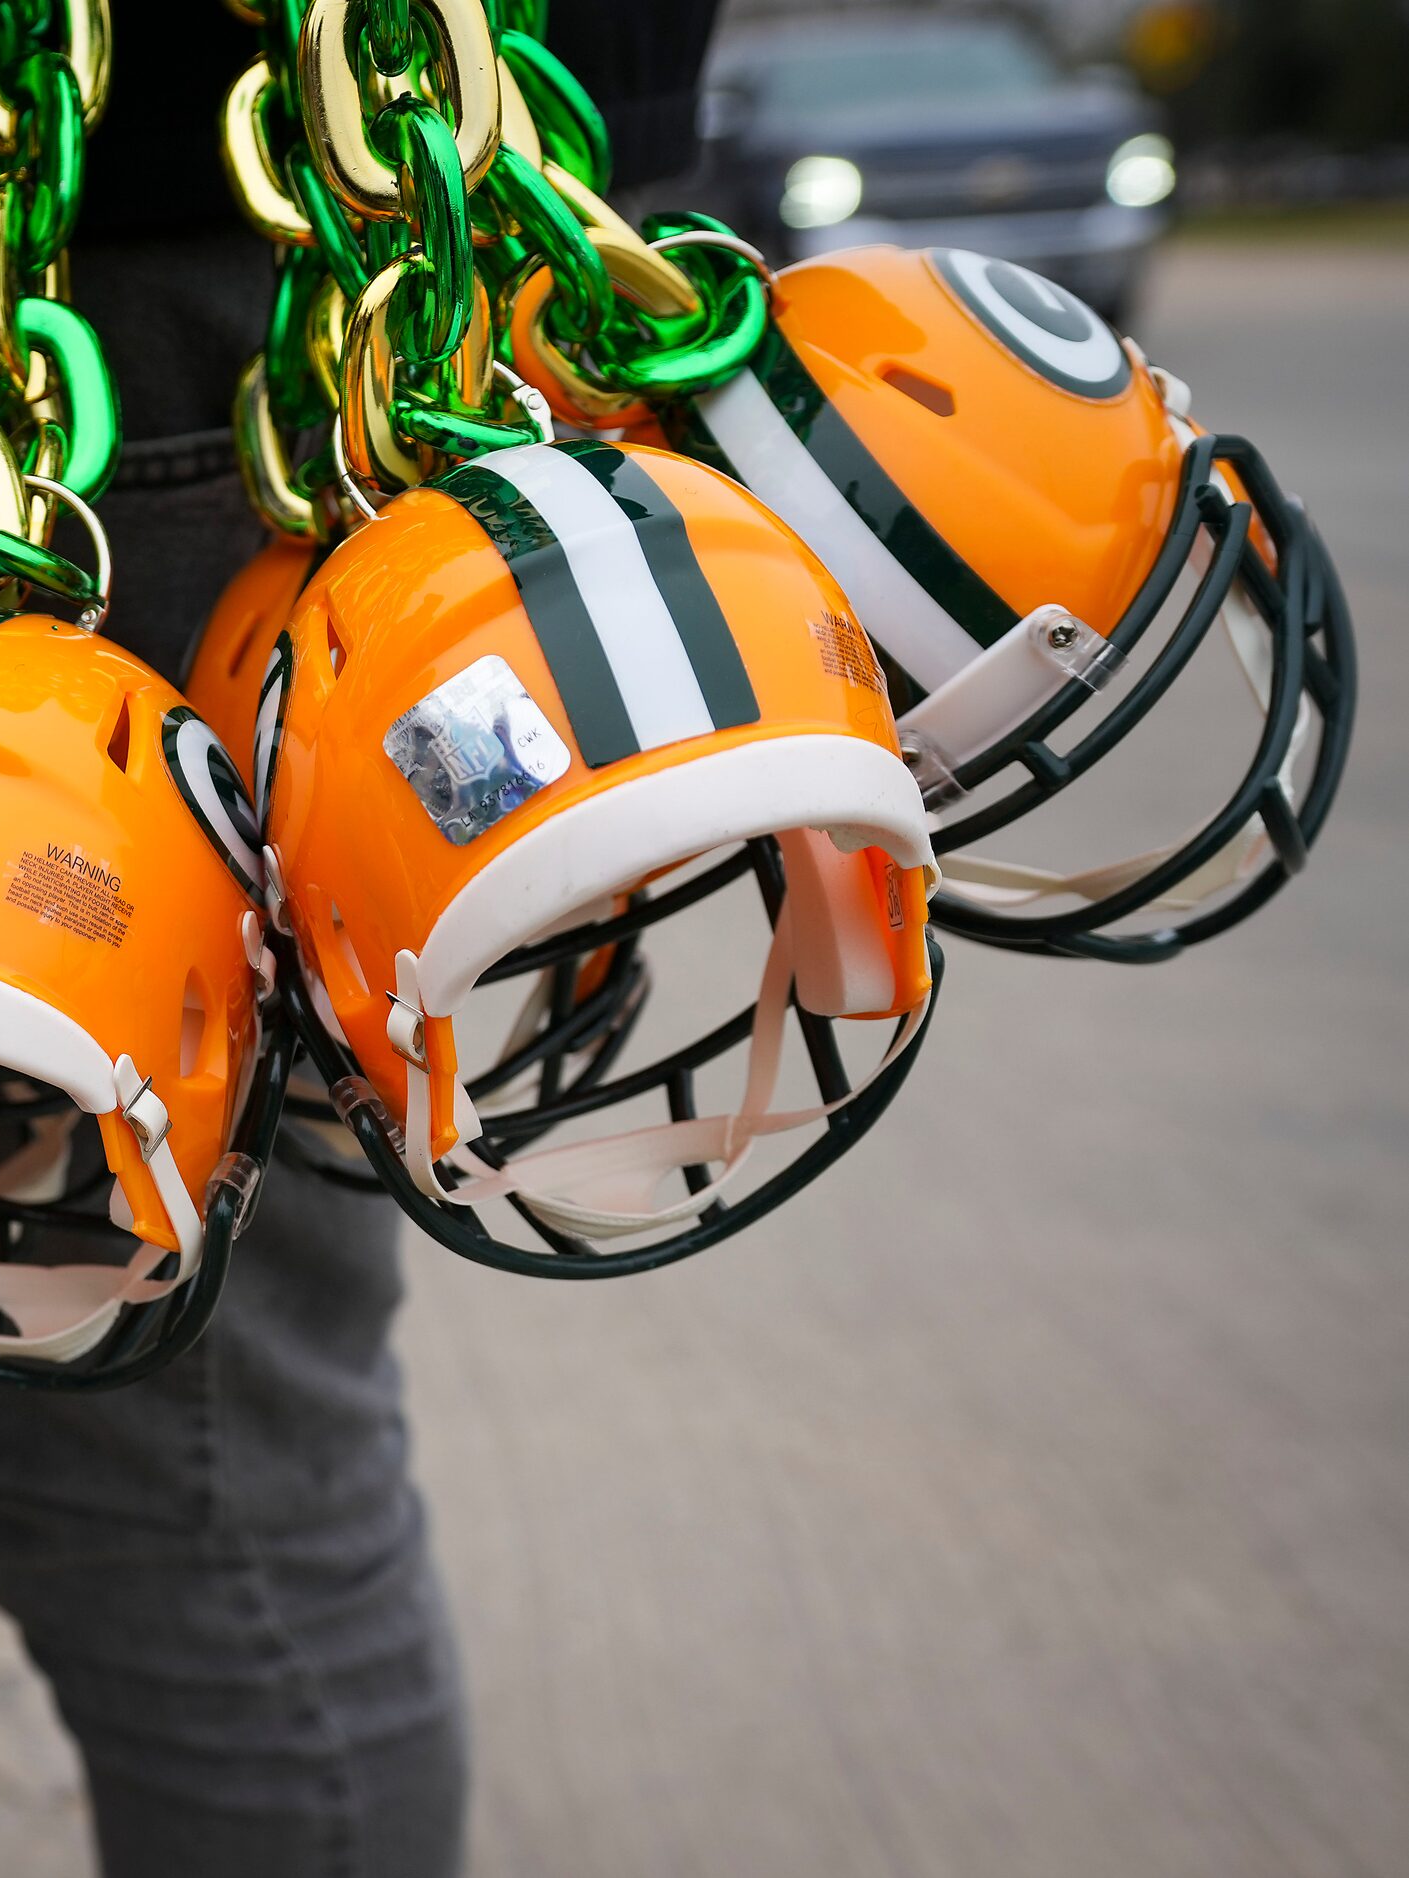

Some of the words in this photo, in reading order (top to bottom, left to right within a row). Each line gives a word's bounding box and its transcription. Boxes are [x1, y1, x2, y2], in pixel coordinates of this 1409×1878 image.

[517, 727, 543, 747] CWK
[445, 733, 497, 778] NFL
[460, 809, 477, 827] LA
[46, 843, 122, 893] WARNING
